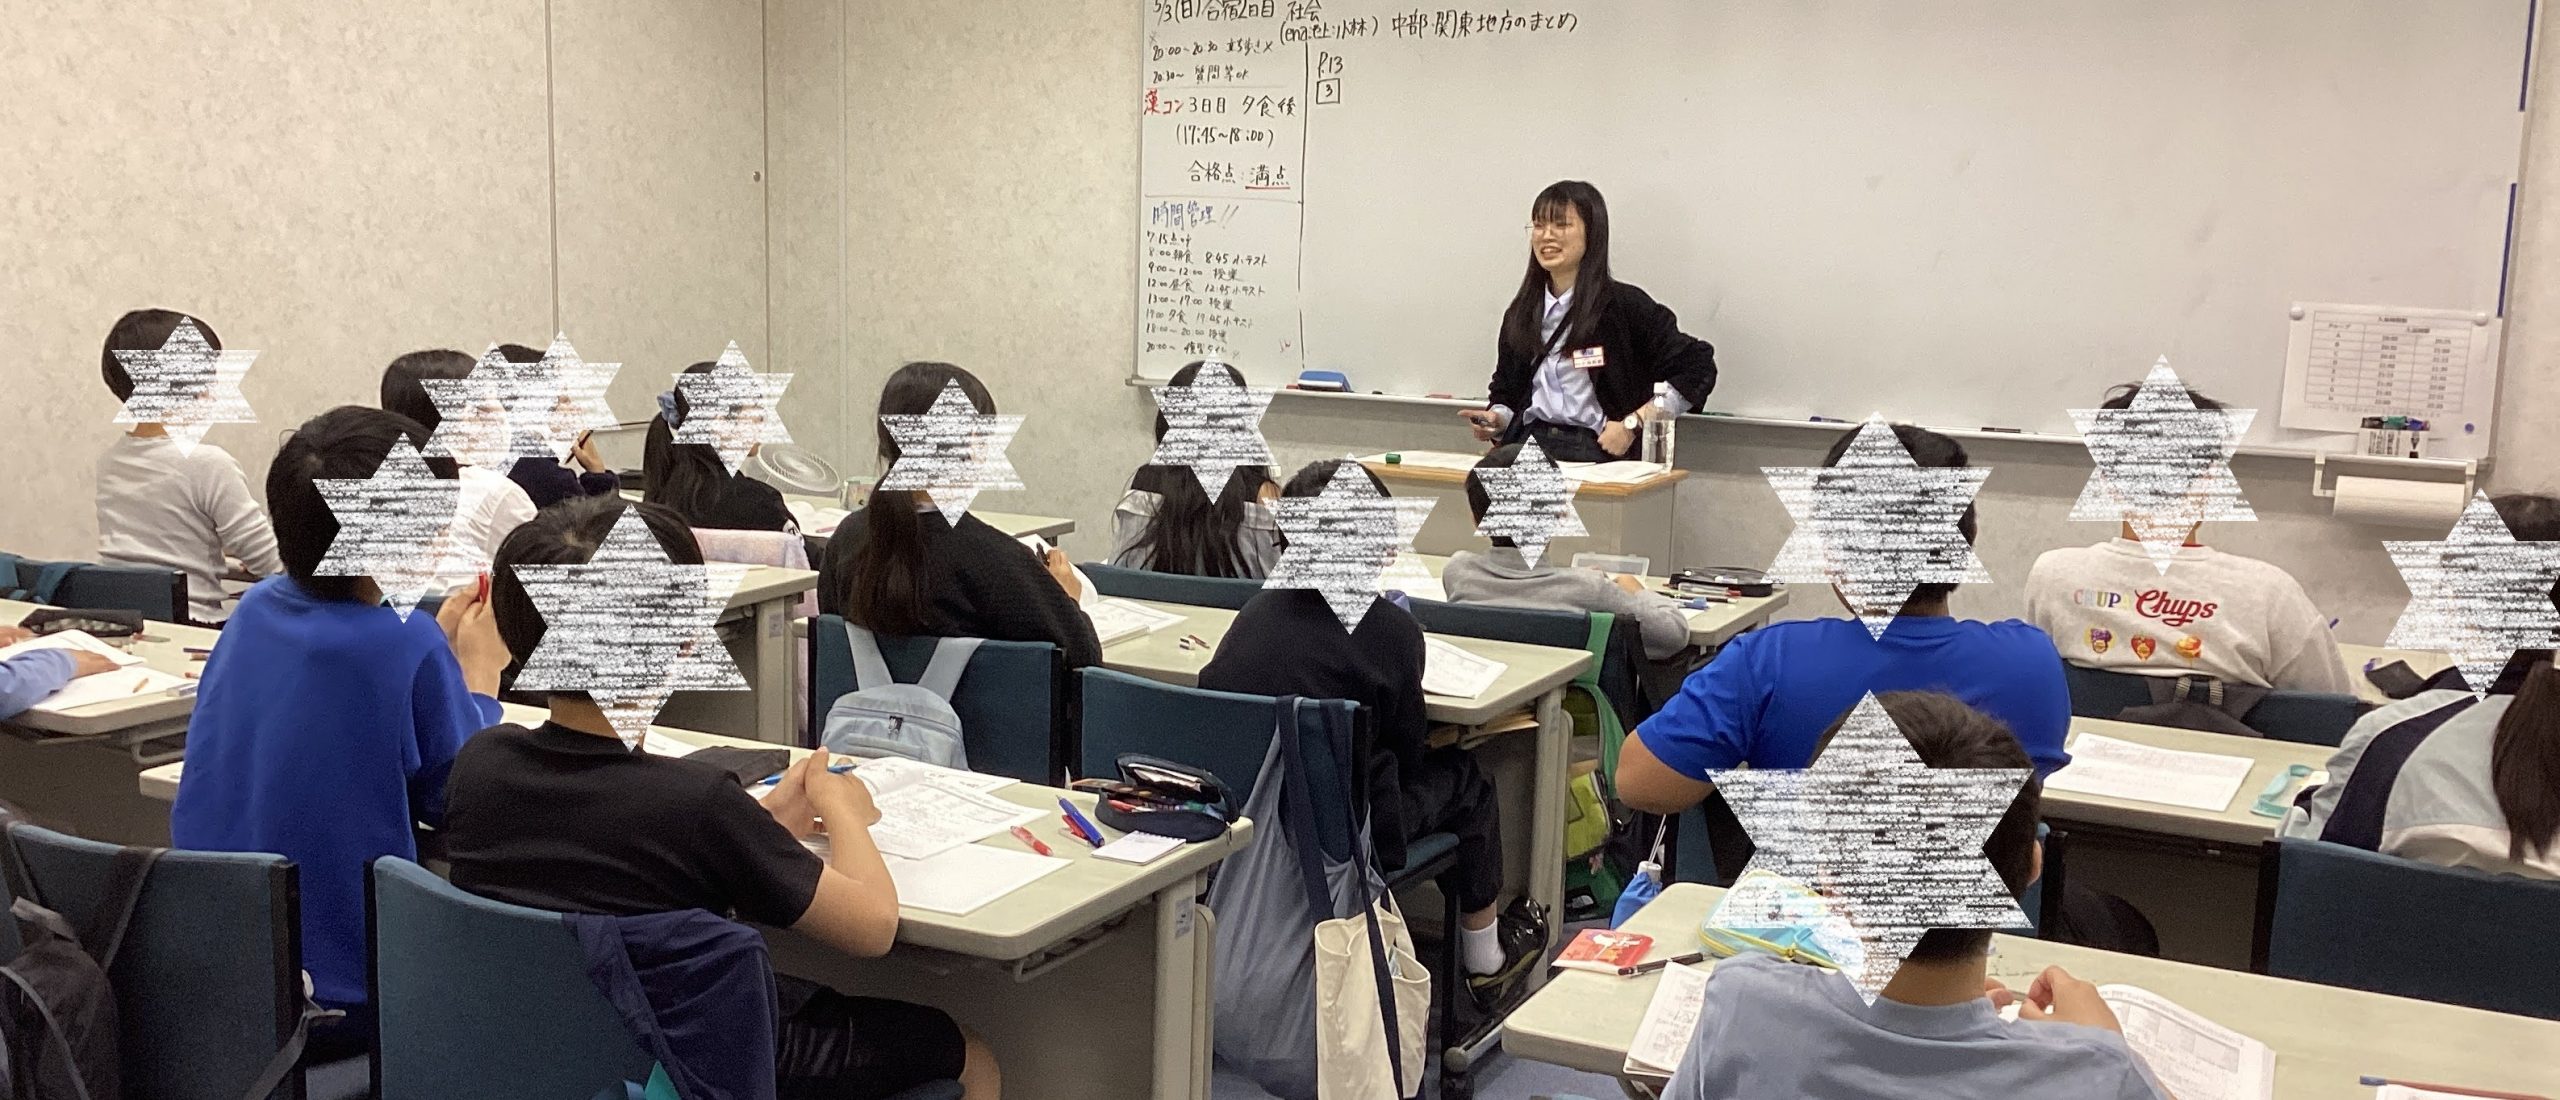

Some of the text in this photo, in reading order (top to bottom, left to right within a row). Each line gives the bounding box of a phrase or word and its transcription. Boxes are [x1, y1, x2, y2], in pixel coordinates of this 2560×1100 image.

[1243, 95, 1297, 118] 夕食後
[2134, 589, 2219, 627] Chups
